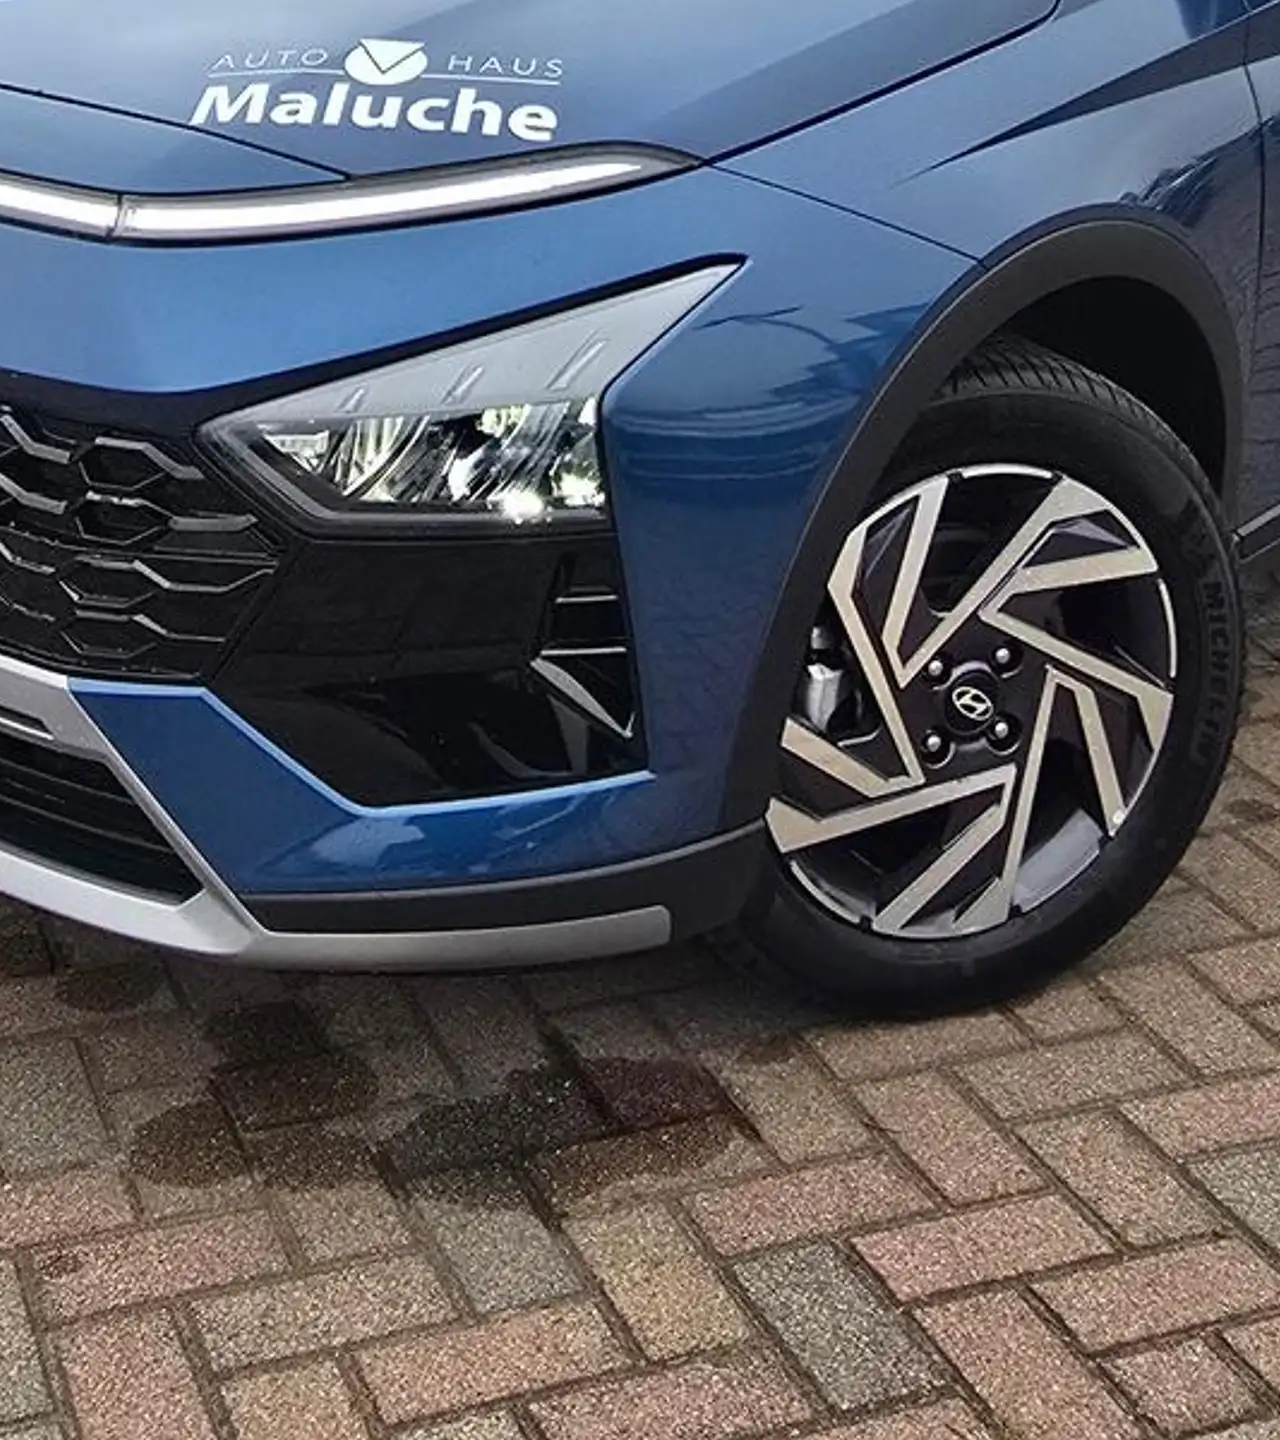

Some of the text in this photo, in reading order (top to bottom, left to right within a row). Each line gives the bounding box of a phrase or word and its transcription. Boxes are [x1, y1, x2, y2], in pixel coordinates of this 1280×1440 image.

[211, 48, 563, 78] AUTO HAUS
[188, 82, 559, 142] Maluche
